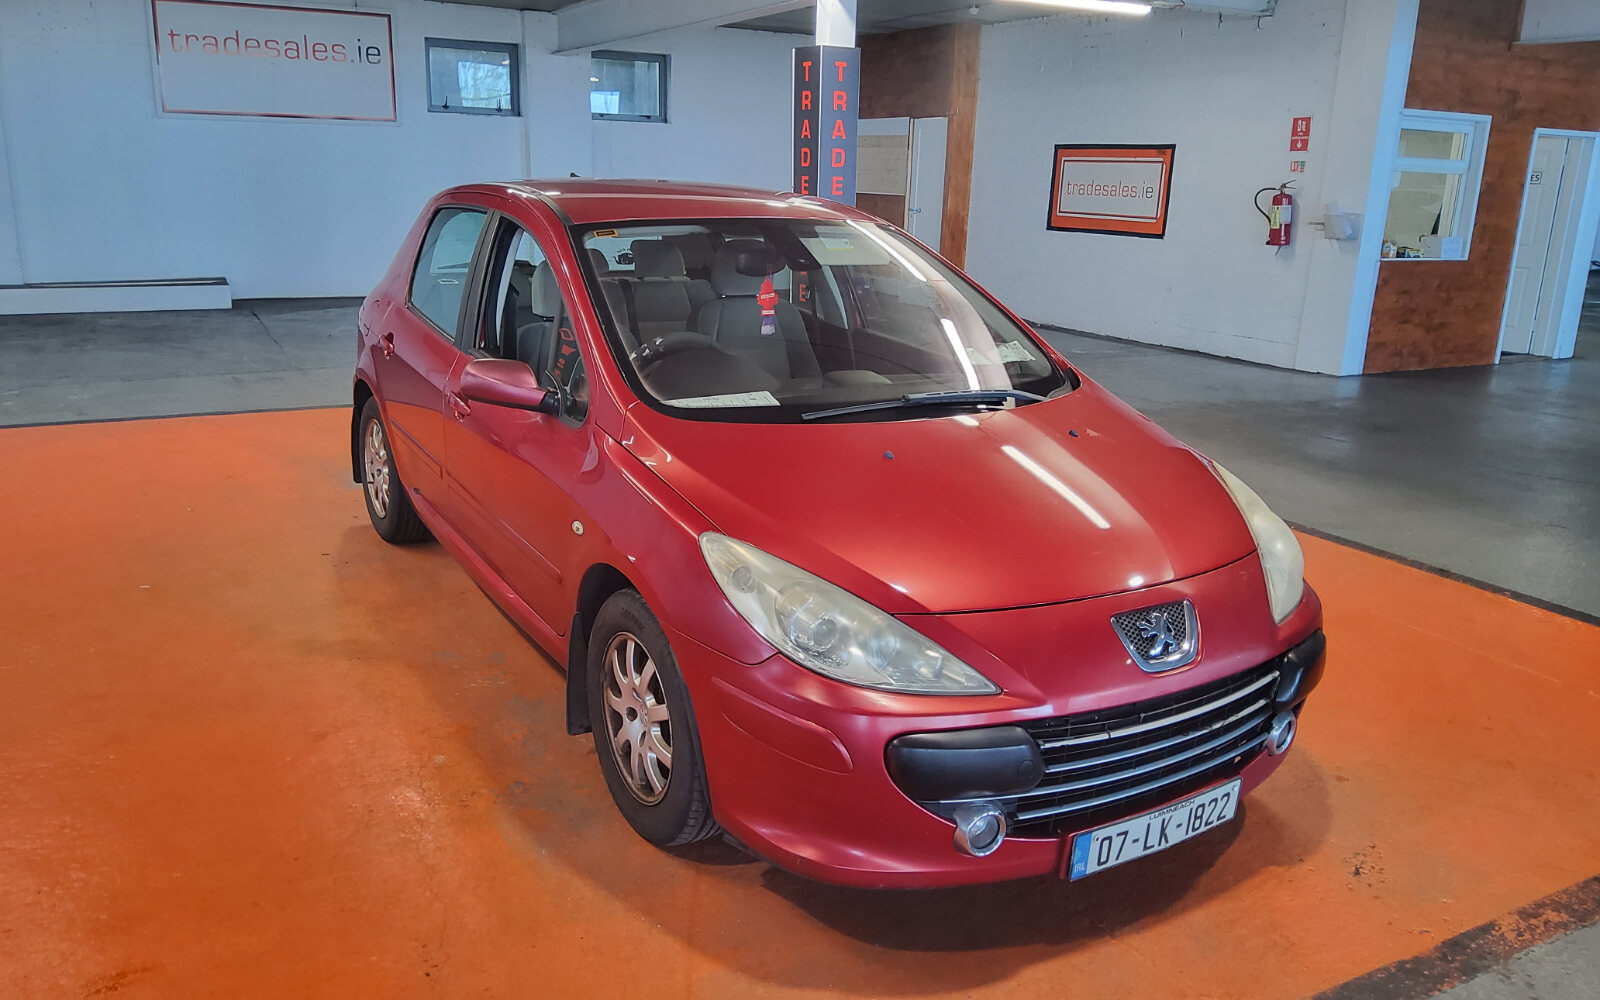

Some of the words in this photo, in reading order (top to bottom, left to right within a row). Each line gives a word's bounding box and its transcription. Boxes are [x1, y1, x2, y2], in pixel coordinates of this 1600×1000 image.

[168, 29, 382, 65] tradesales.ie
[801, 61, 812, 195] TRADE
[832, 61, 848, 196] TRADE
[1066, 179, 1154, 199] tradesales.ie
[1097, 792, 1231, 867] 07-LK-1822
[1149, 800, 1195, 820] LUIMNEACH
